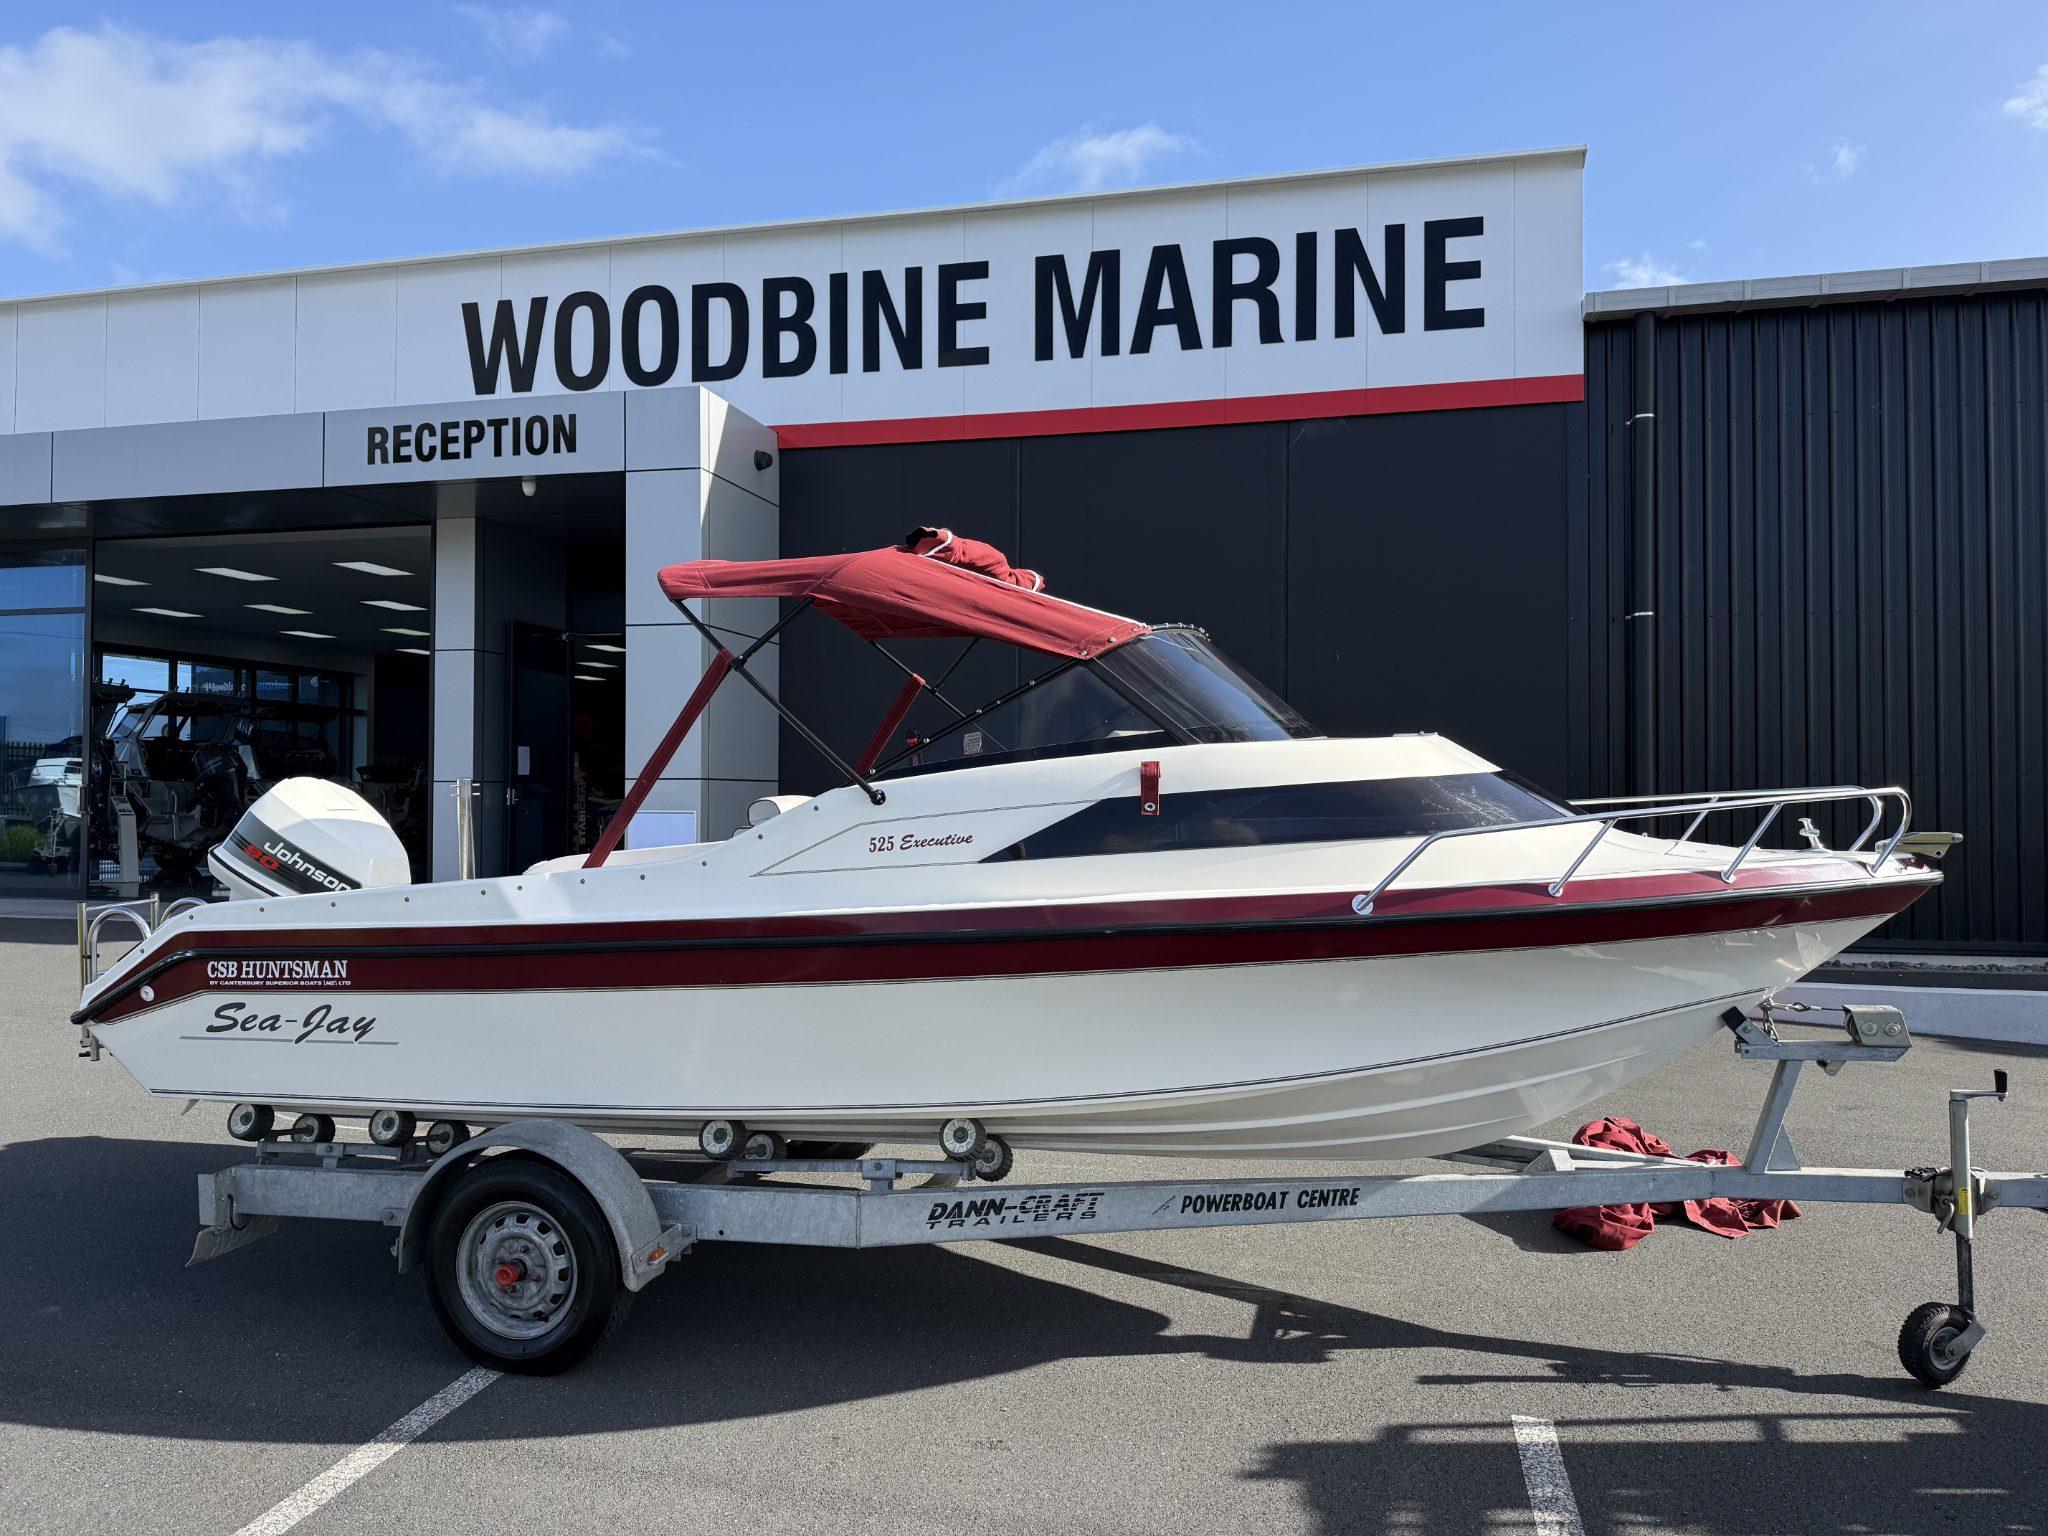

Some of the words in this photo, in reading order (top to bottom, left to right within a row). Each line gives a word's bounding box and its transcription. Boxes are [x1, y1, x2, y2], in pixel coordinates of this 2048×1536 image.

[461, 260, 990, 396] WOODBINE
[1034, 216, 1485, 362] MARINE
[366, 413, 577, 466] RECEPTION
[869, 836, 895, 852] 525
[900, 834, 973, 851] Executive
[263, 841, 352, 892] Johnson
[207, 960, 238, 979] CSB
[240, 960, 348, 979] HUNTSMAN
[206, 1002, 376, 1044] Sea-Jay
[927, 1191, 1105, 1221] DANN-CRAFT
[1180, 1191, 1290, 1214] POWERBOAT
[1297, 1187, 1361, 1208] CENTRE
[925, 1211, 1098, 1230] TRAILERS
